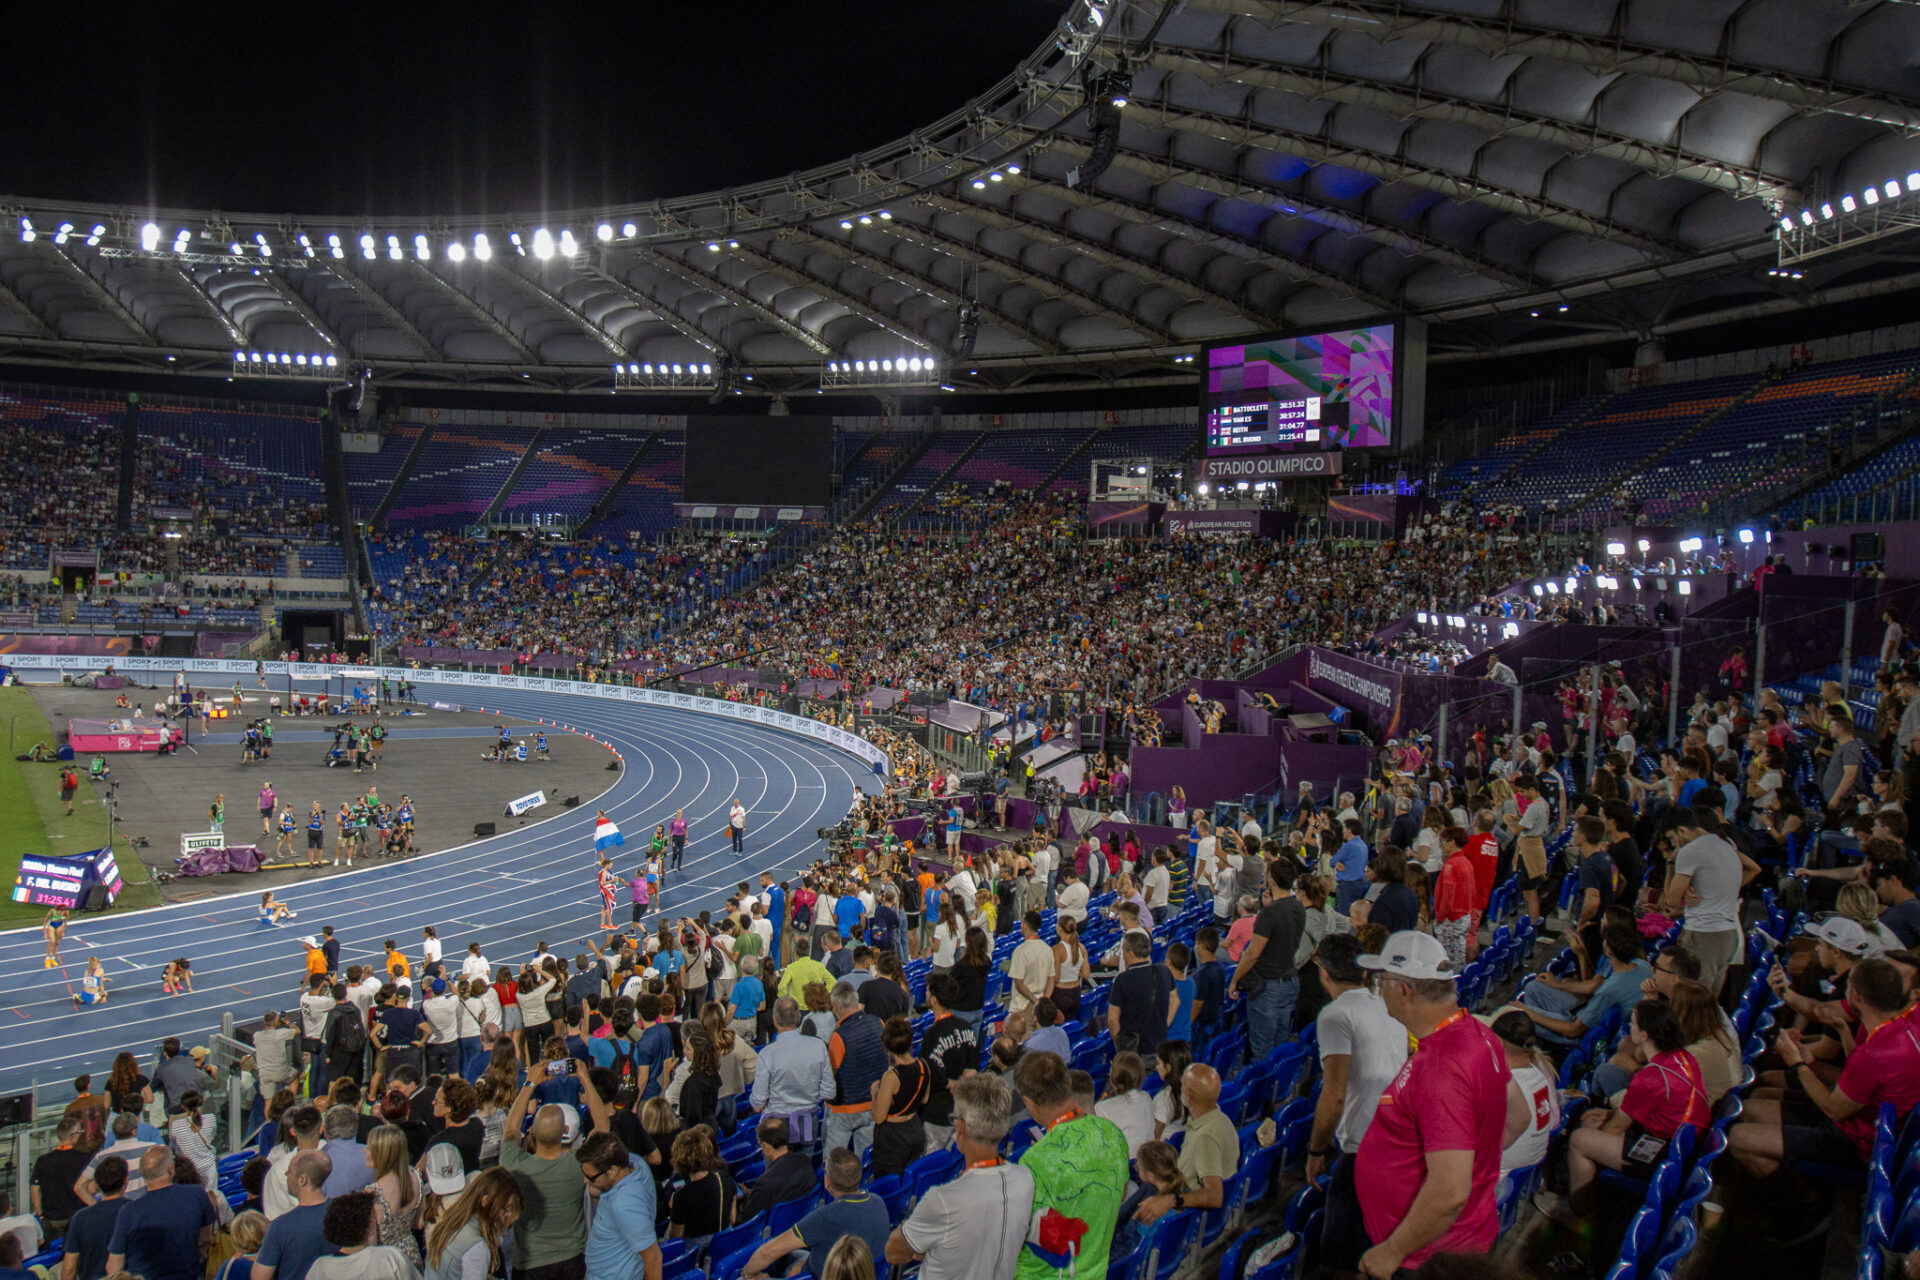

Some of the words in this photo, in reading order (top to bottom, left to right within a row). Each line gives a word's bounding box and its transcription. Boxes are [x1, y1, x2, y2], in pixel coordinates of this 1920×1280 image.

[1280, 400, 1305, 409] 30:51.32
[1280, 411, 1305, 420] 30:57.24
[1279, 422, 1305, 430] 31:04.77
[1279, 432, 1304, 441] 31:25.41
[1209, 461, 1255, 475] STADIO
[1257, 457, 1324, 473] OLIMPICO
[1355, 675, 1392, 708] CHAMPIONSHIPS
[190, 839, 219, 848] ULIVETO
[1481, 844, 1498, 856] SUI
[36, 892, 76, 908] 31:25.41
